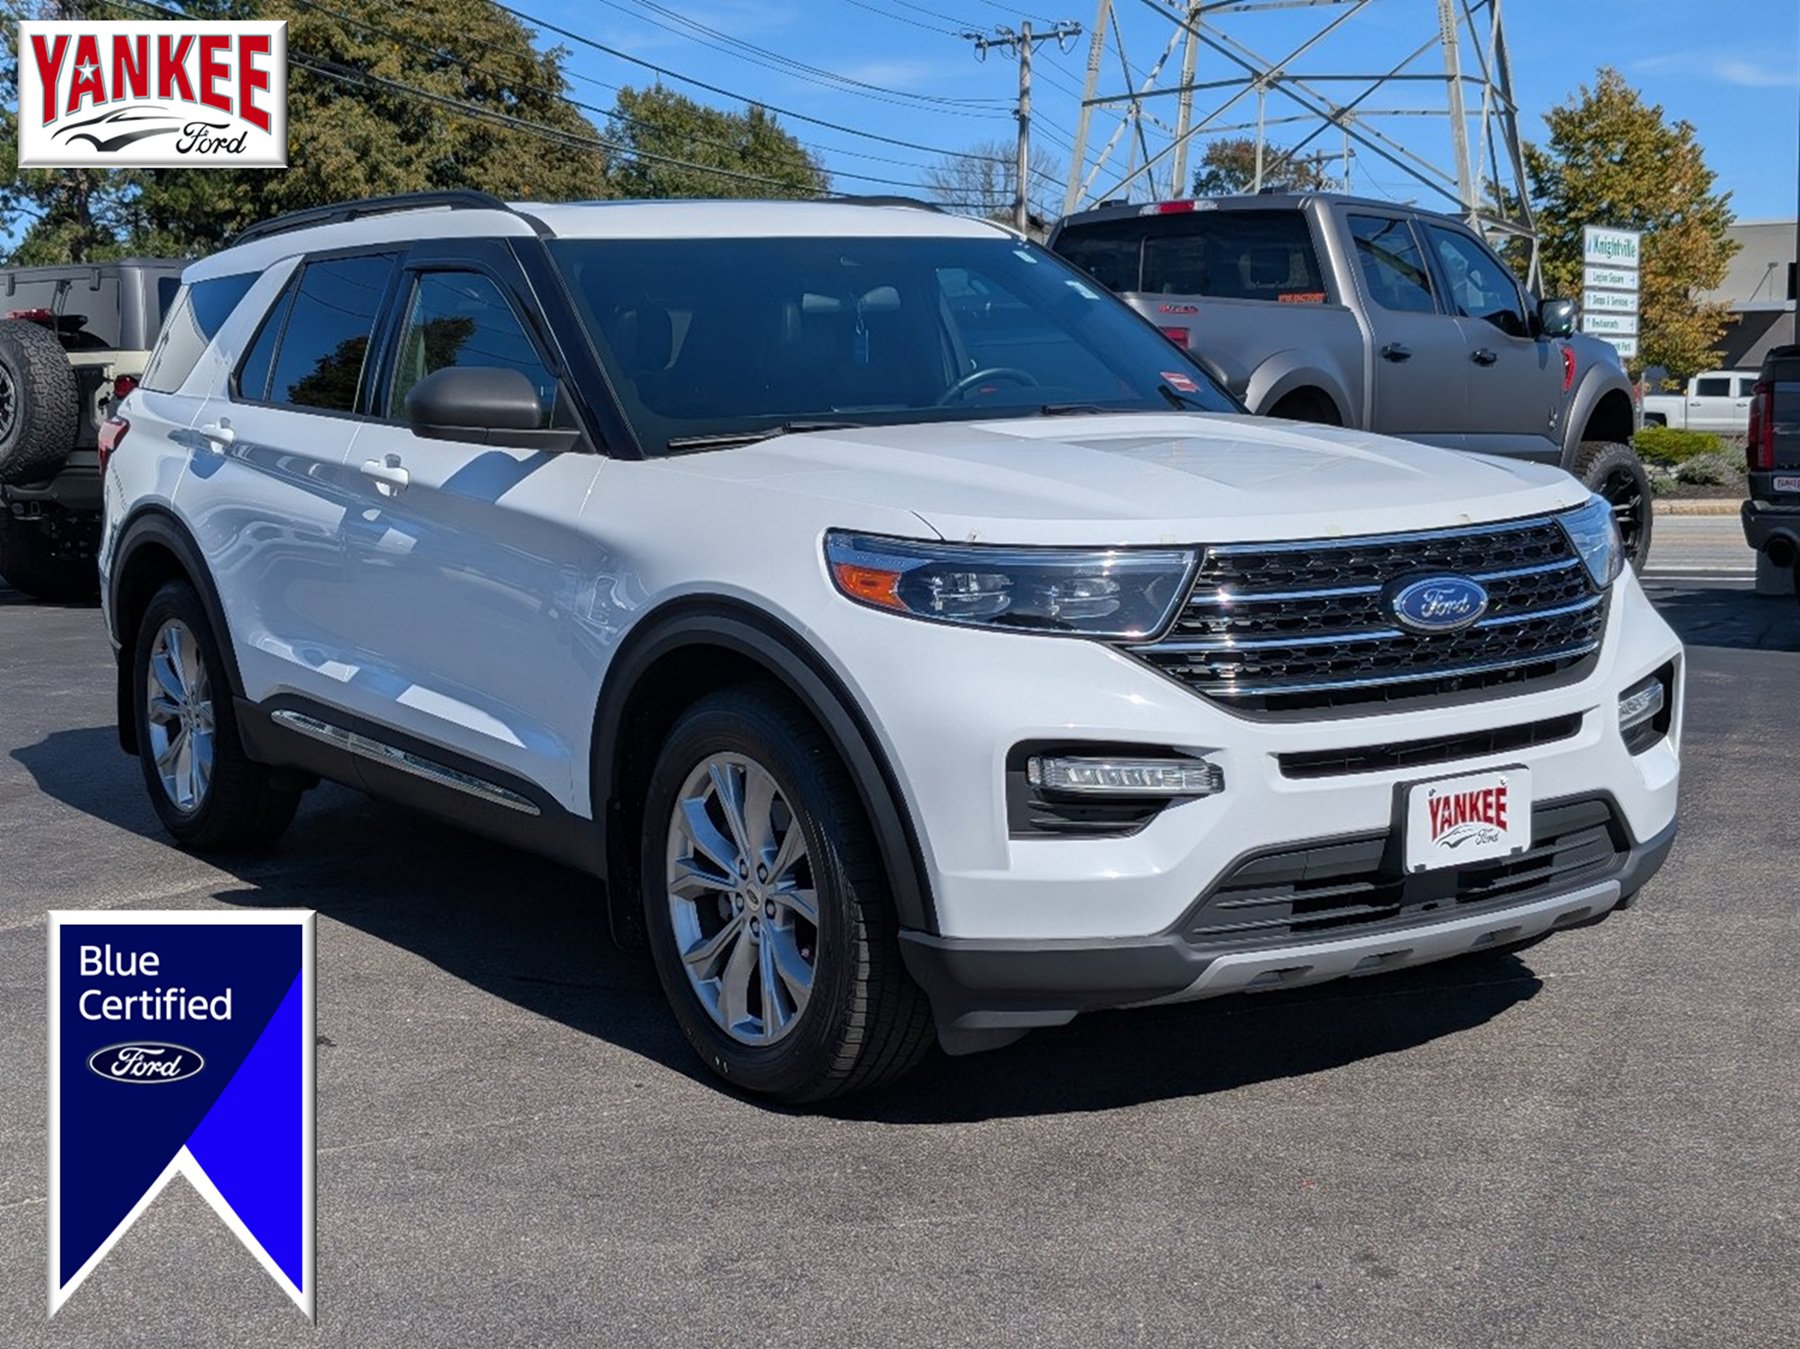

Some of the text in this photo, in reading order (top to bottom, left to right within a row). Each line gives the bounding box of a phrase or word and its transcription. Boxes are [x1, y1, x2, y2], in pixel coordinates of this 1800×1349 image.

[1592, 234, 1636, 258] Knightville
[1421, 588, 1470, 617] Ford
[1429, 787, 1508, 842] YANKEE
[1475, 828, 1499, 845] Ford
